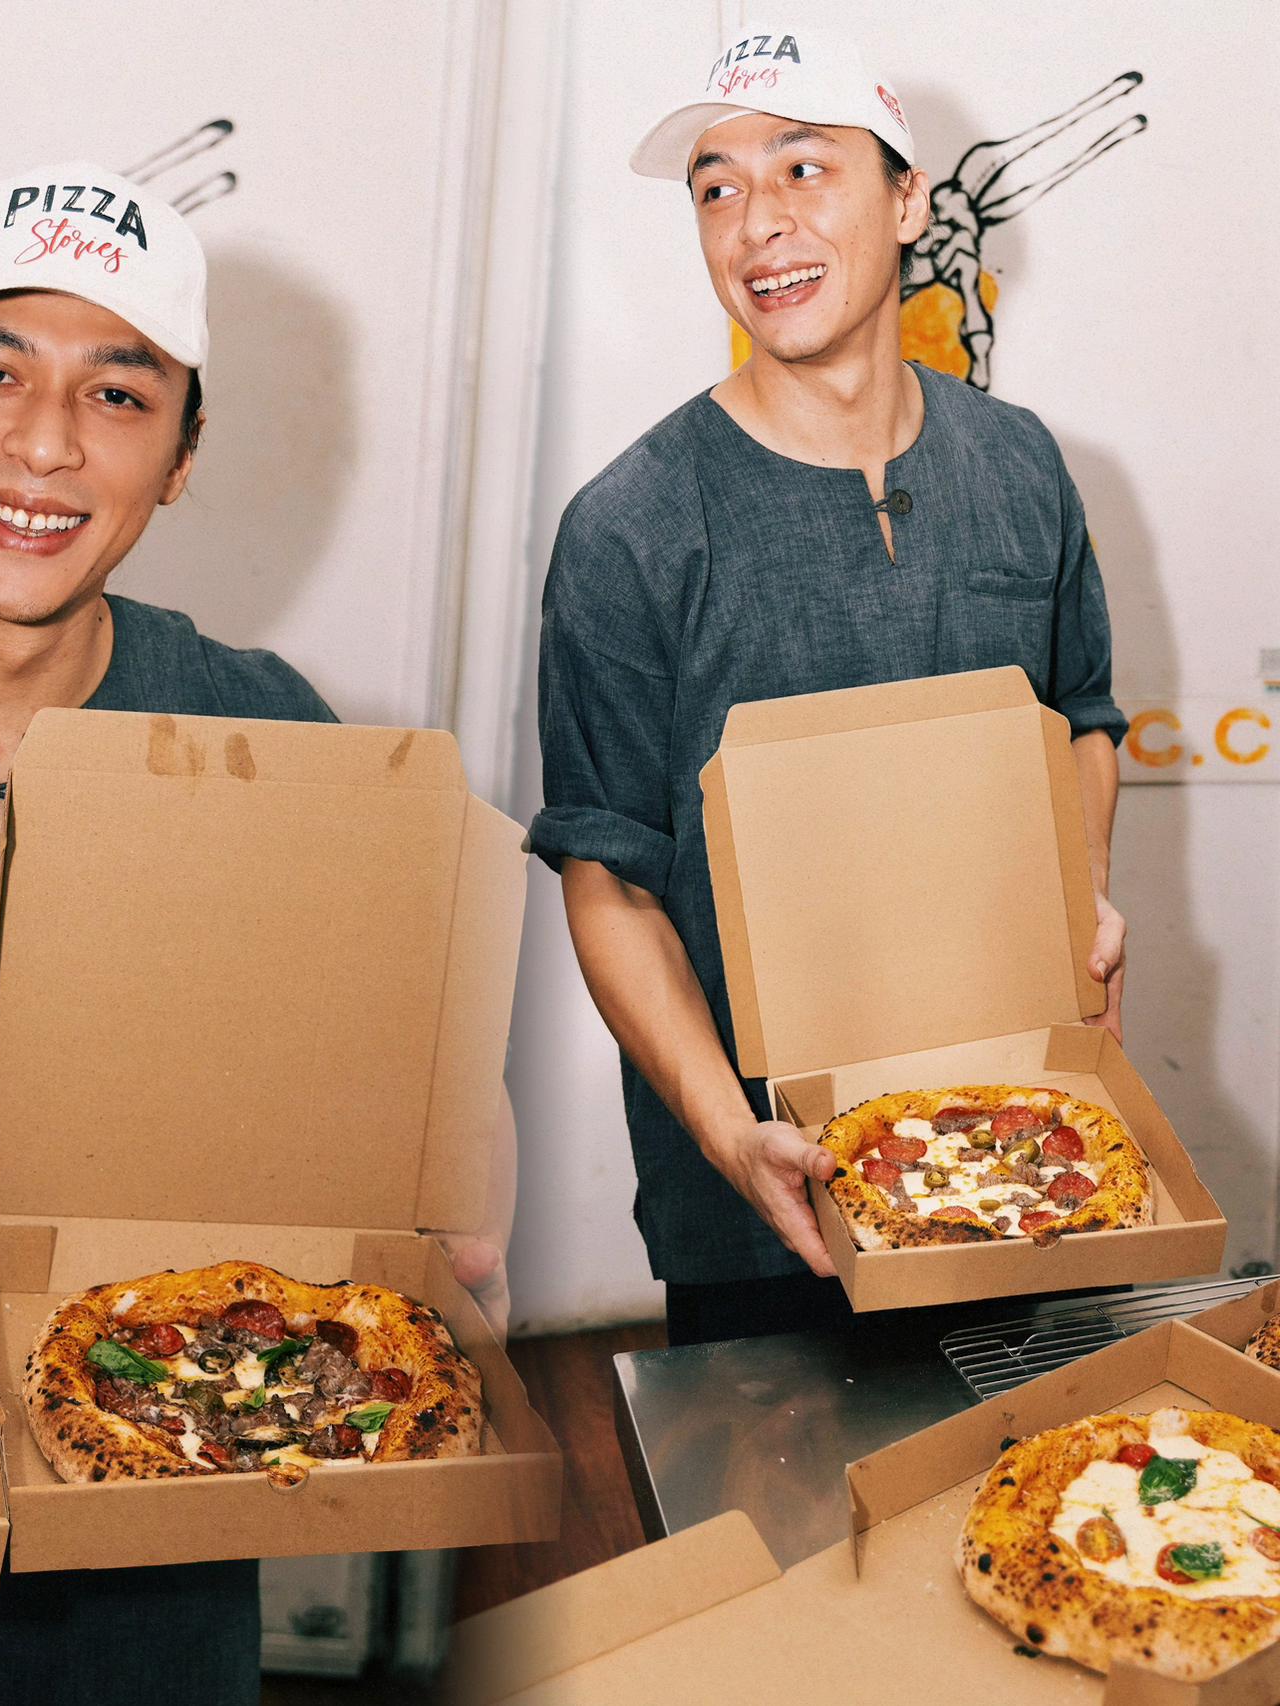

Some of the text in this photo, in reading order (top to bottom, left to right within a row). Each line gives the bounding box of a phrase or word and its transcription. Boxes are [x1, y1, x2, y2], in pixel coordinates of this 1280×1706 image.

[705, 34, 801, 92] PIZZA
[3, 184, 148, 251] PIZZA
[14, 218, 128, 273] Stories
